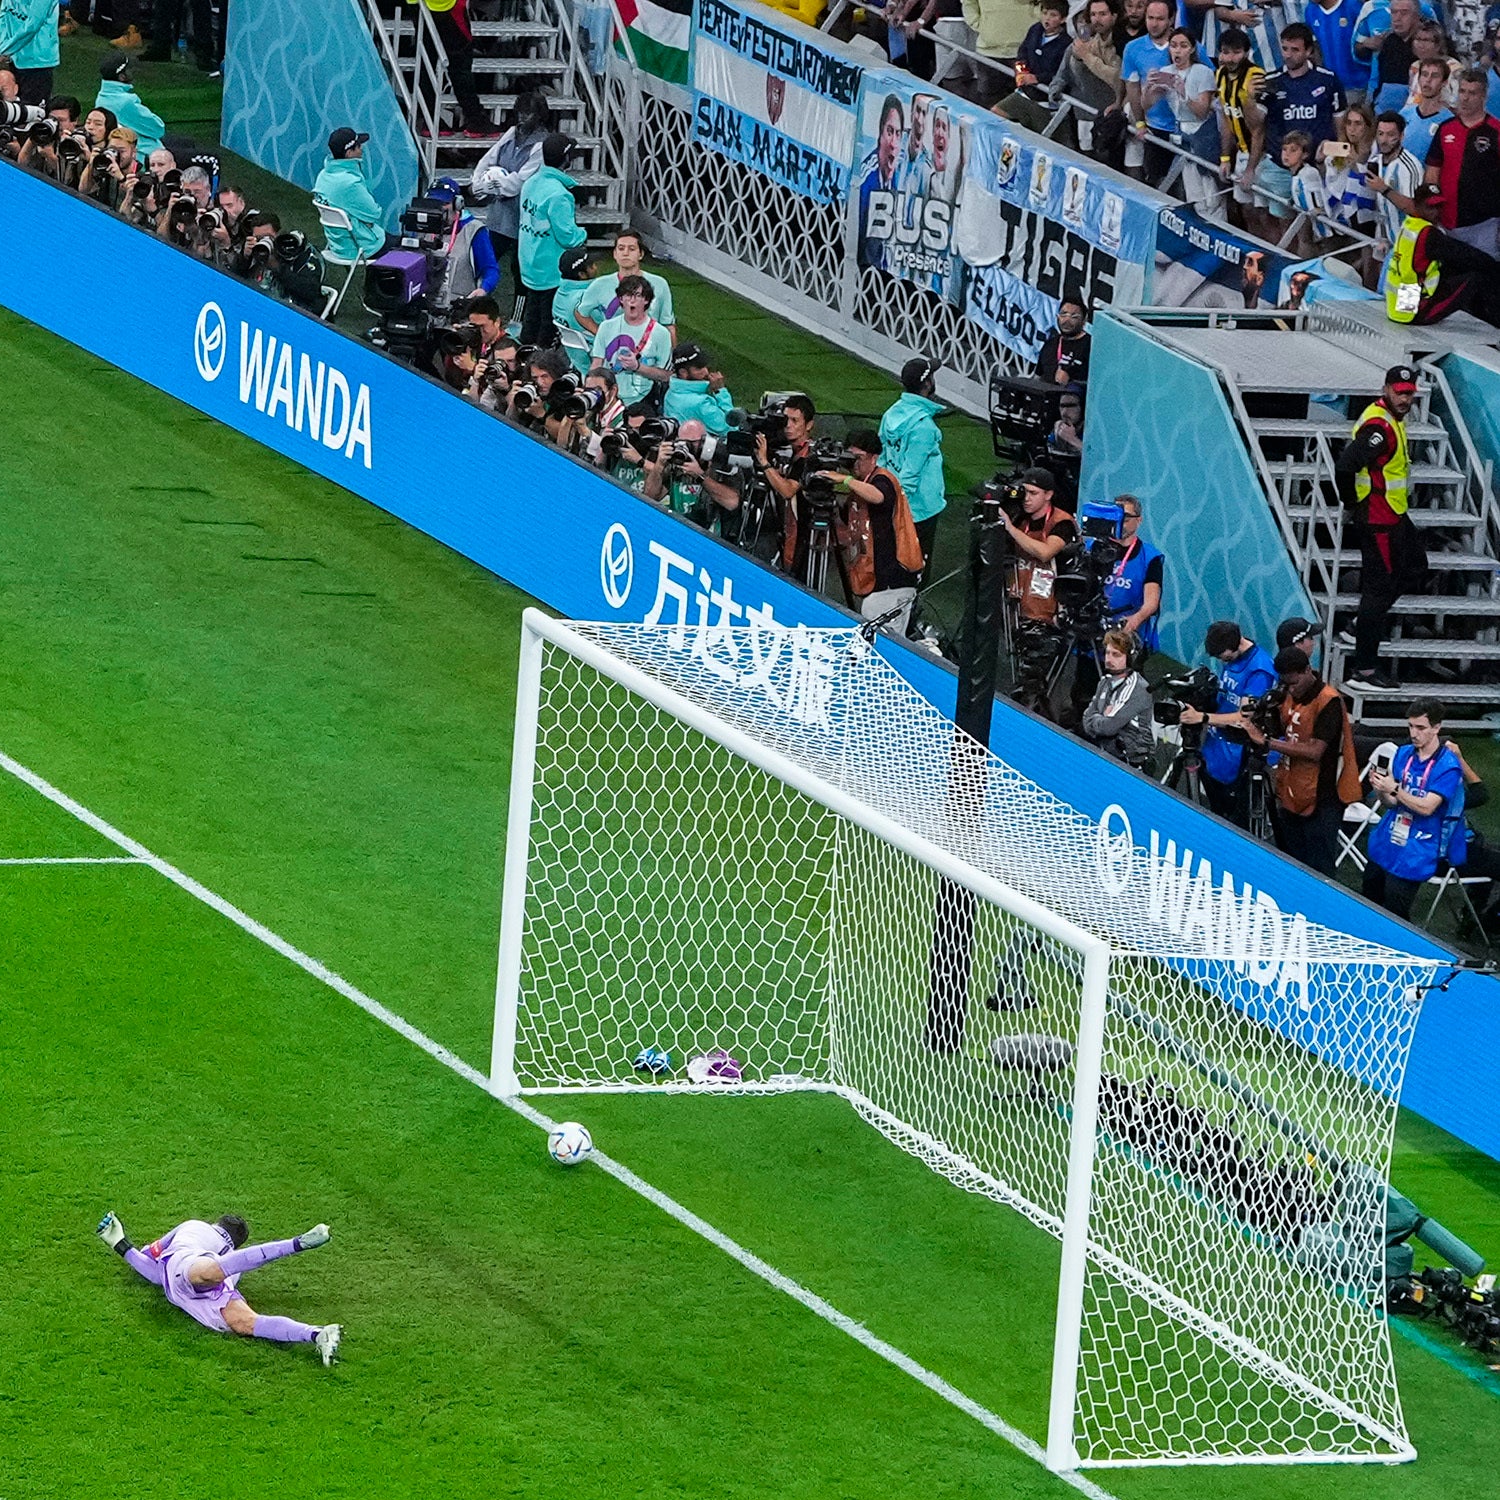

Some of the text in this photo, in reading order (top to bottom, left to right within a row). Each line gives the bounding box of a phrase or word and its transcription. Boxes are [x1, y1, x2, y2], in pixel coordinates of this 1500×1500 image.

[697, 98, 844, 201] SAN MARTIN
[1283, 104, 1317, 120] antel
[894, 243, 950, 276] Presente
[239, 321, 373, 469] WANDA
[1150, 829, 1309, 1013] WANDA
